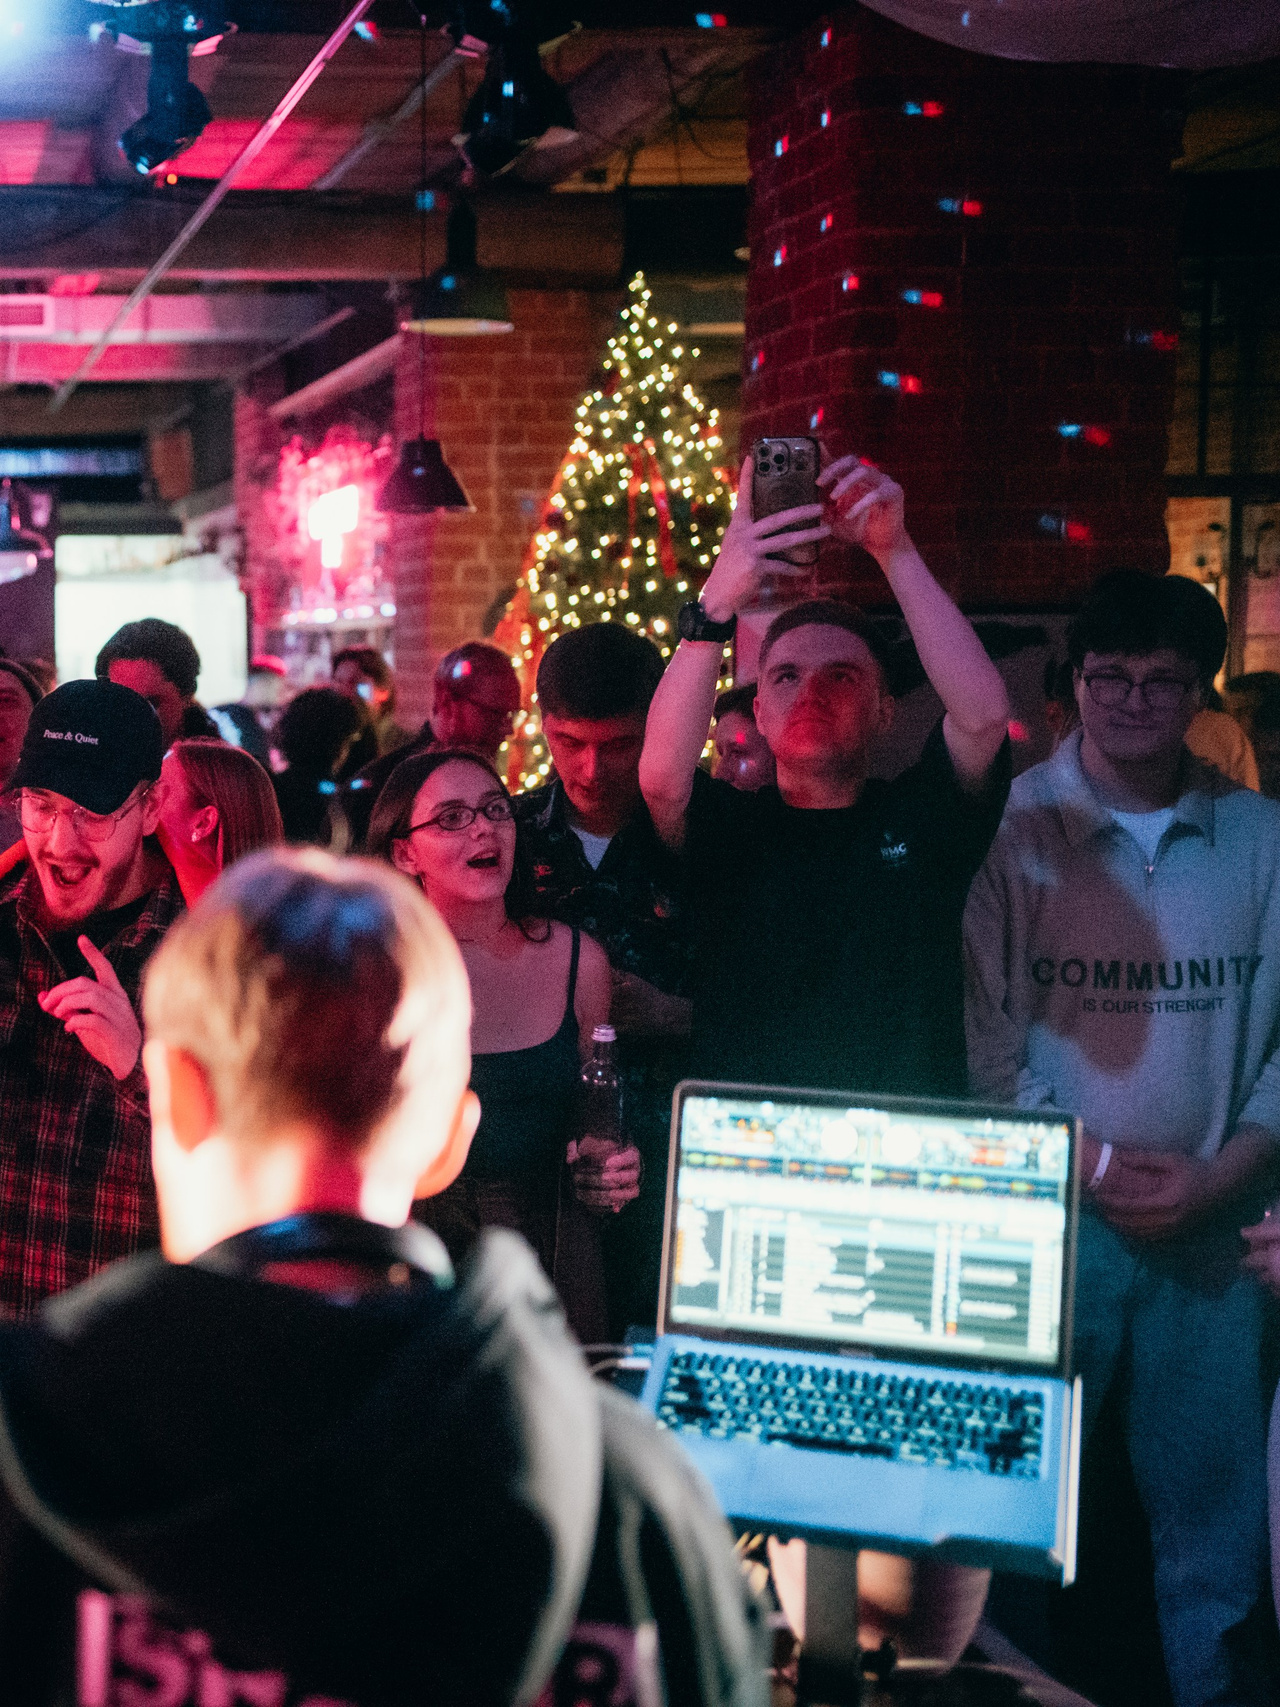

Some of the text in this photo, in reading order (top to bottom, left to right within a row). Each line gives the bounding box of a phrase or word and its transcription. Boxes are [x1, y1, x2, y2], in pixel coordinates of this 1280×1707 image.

[43, 729, 99, 745] Peace & Quiet
[1083, 999, 1097, 1012] IS
[1102, 999, 1139, 1013] OUR
